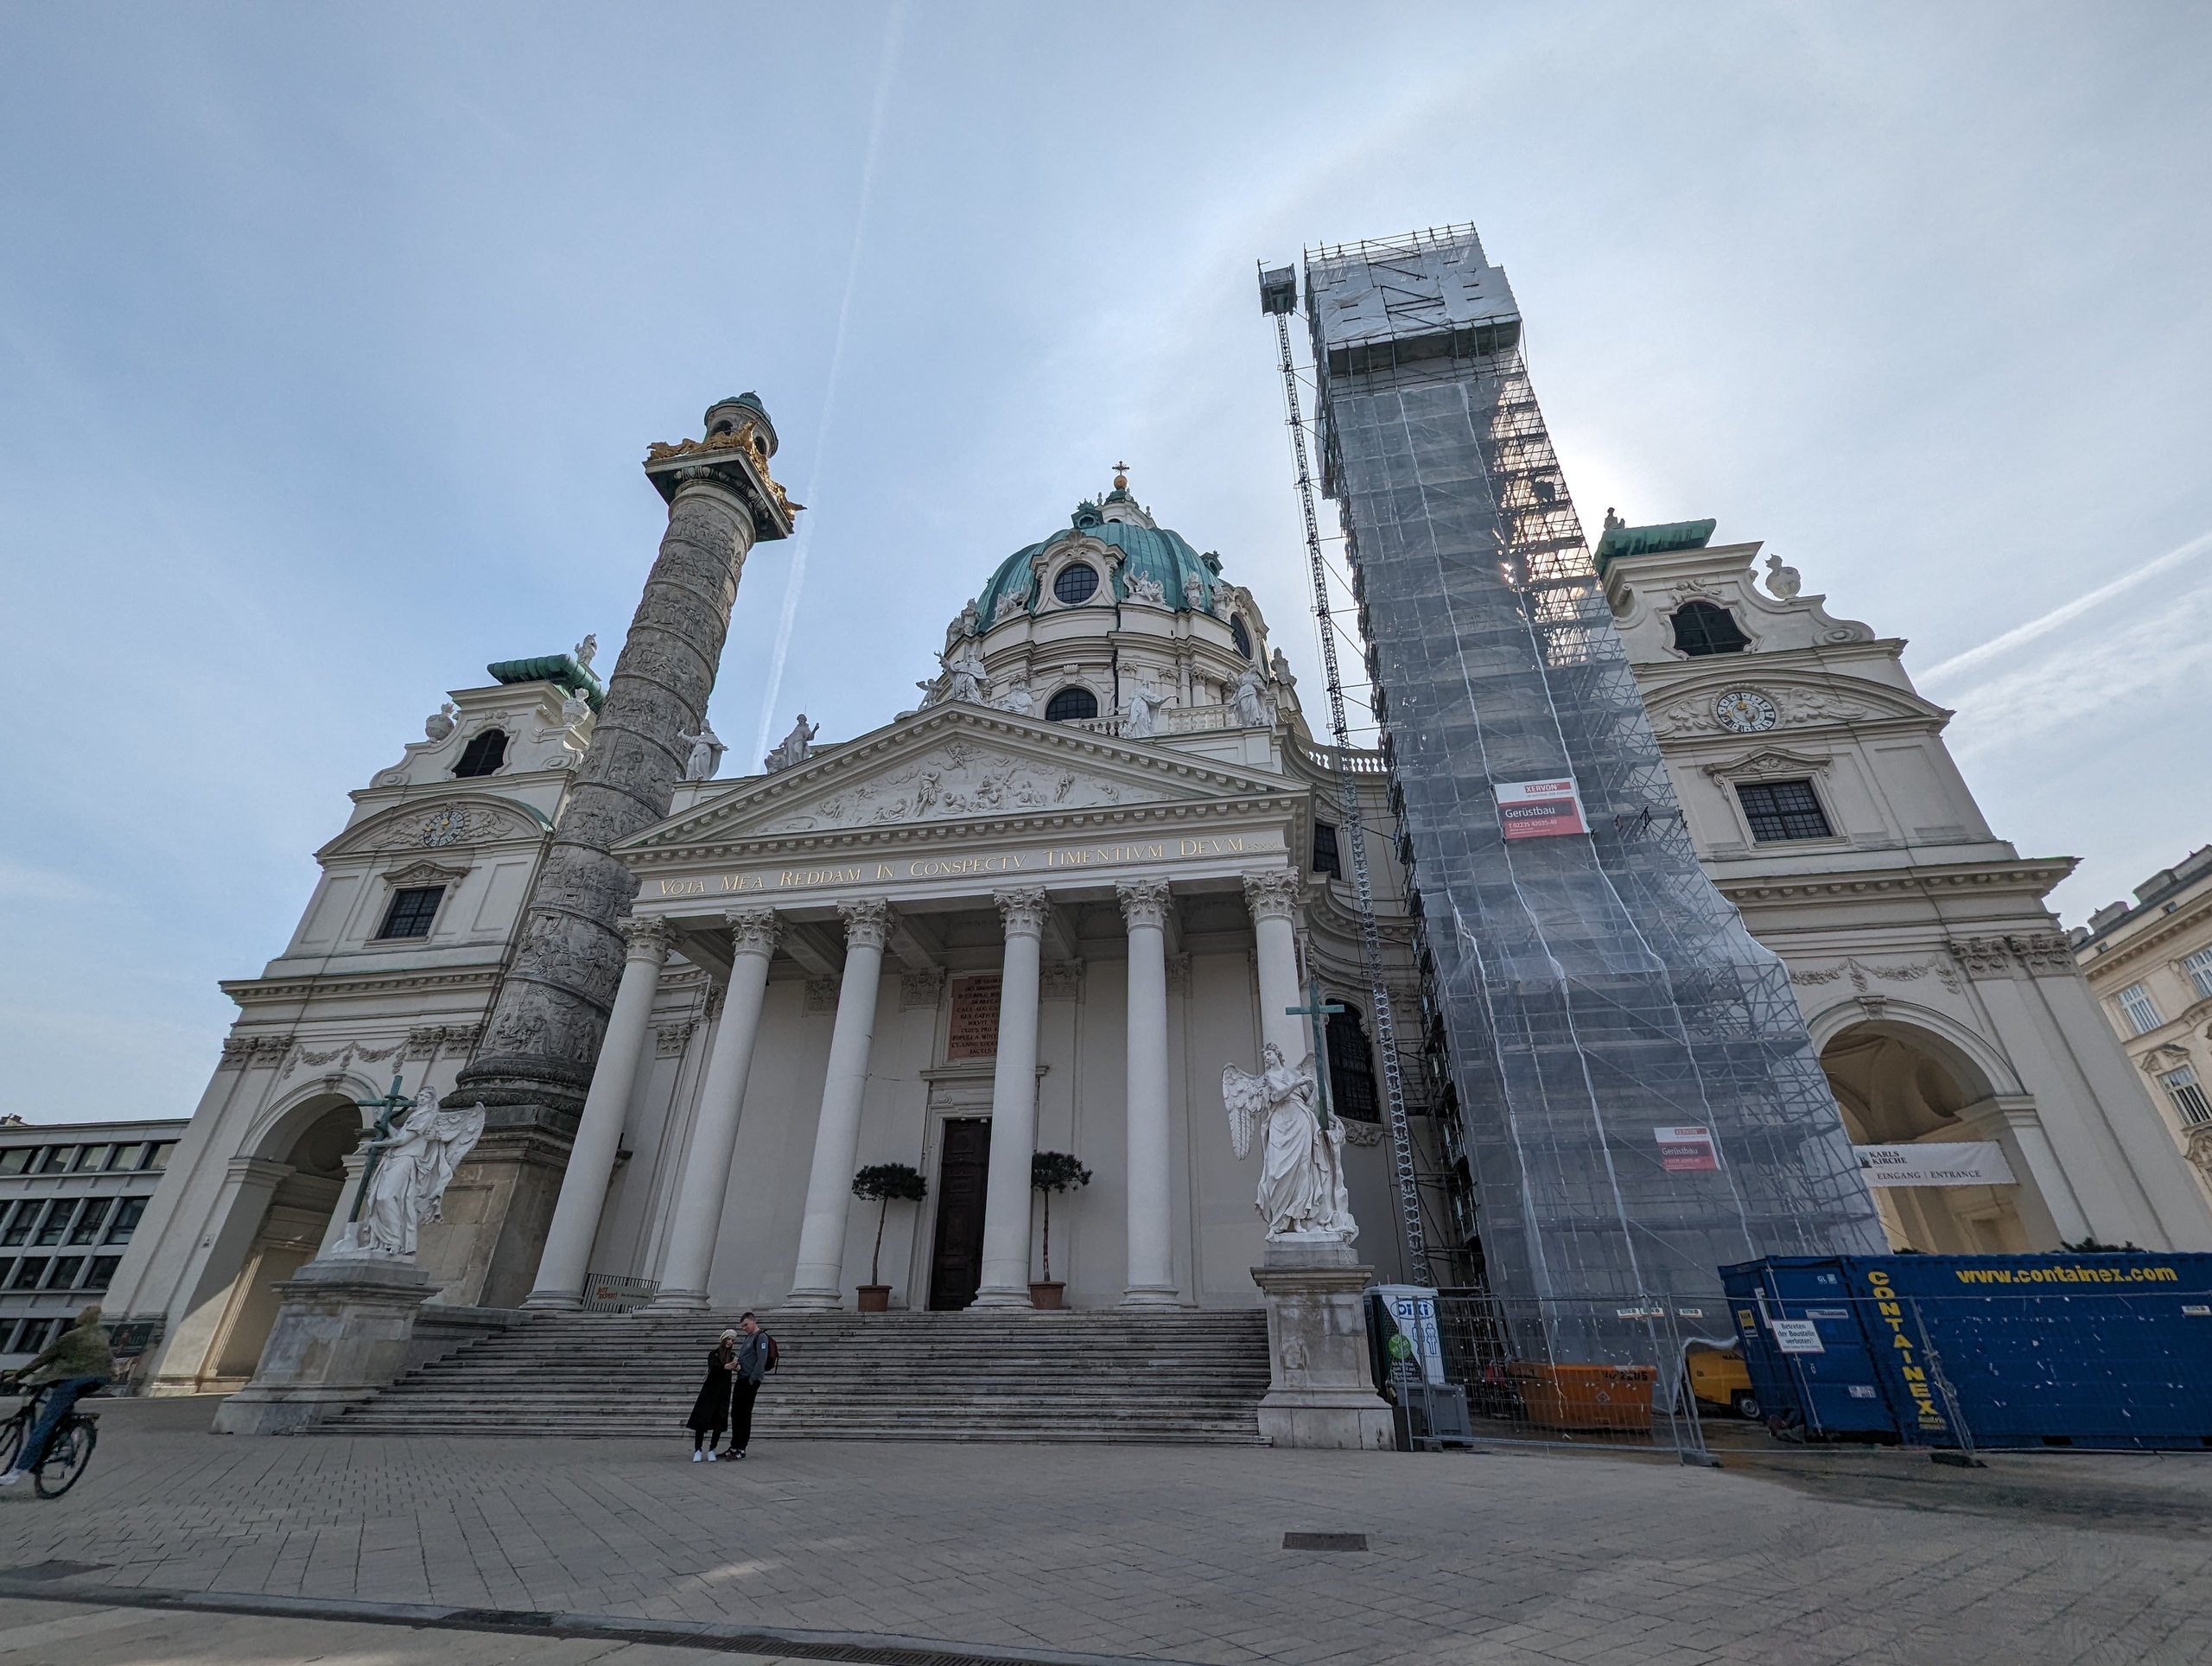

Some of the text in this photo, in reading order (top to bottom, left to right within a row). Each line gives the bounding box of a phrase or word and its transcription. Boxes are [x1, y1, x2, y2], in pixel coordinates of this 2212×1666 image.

[1526, 784, 1557, 792] XERVON
[1505, 806, 1556, 818] Gerüstbau
[659, 878, 706, 896] VOTA
[720, 874, 764, 892] MEA
[780, 868, 861, 887] REDDAM
[875, 863, 895, 880] IN
[909, 855, 1027, 877] CONSPECTV
[1043, 844, 1163, 868] TIMENTIVM
[1179, 838, 1244, 857] DEVM
[1662, 1147, 1699, 1156] Gerüstbau
[1872, 1156, 1908, 1165] KIRCHE
[1877, 1169, 1982, 1180] EINGANG ENTRANCE
[1955, 1265, 2178, 1283] www.containex.com
[1867, 1271, 1939, 1415] CONTAINEX
